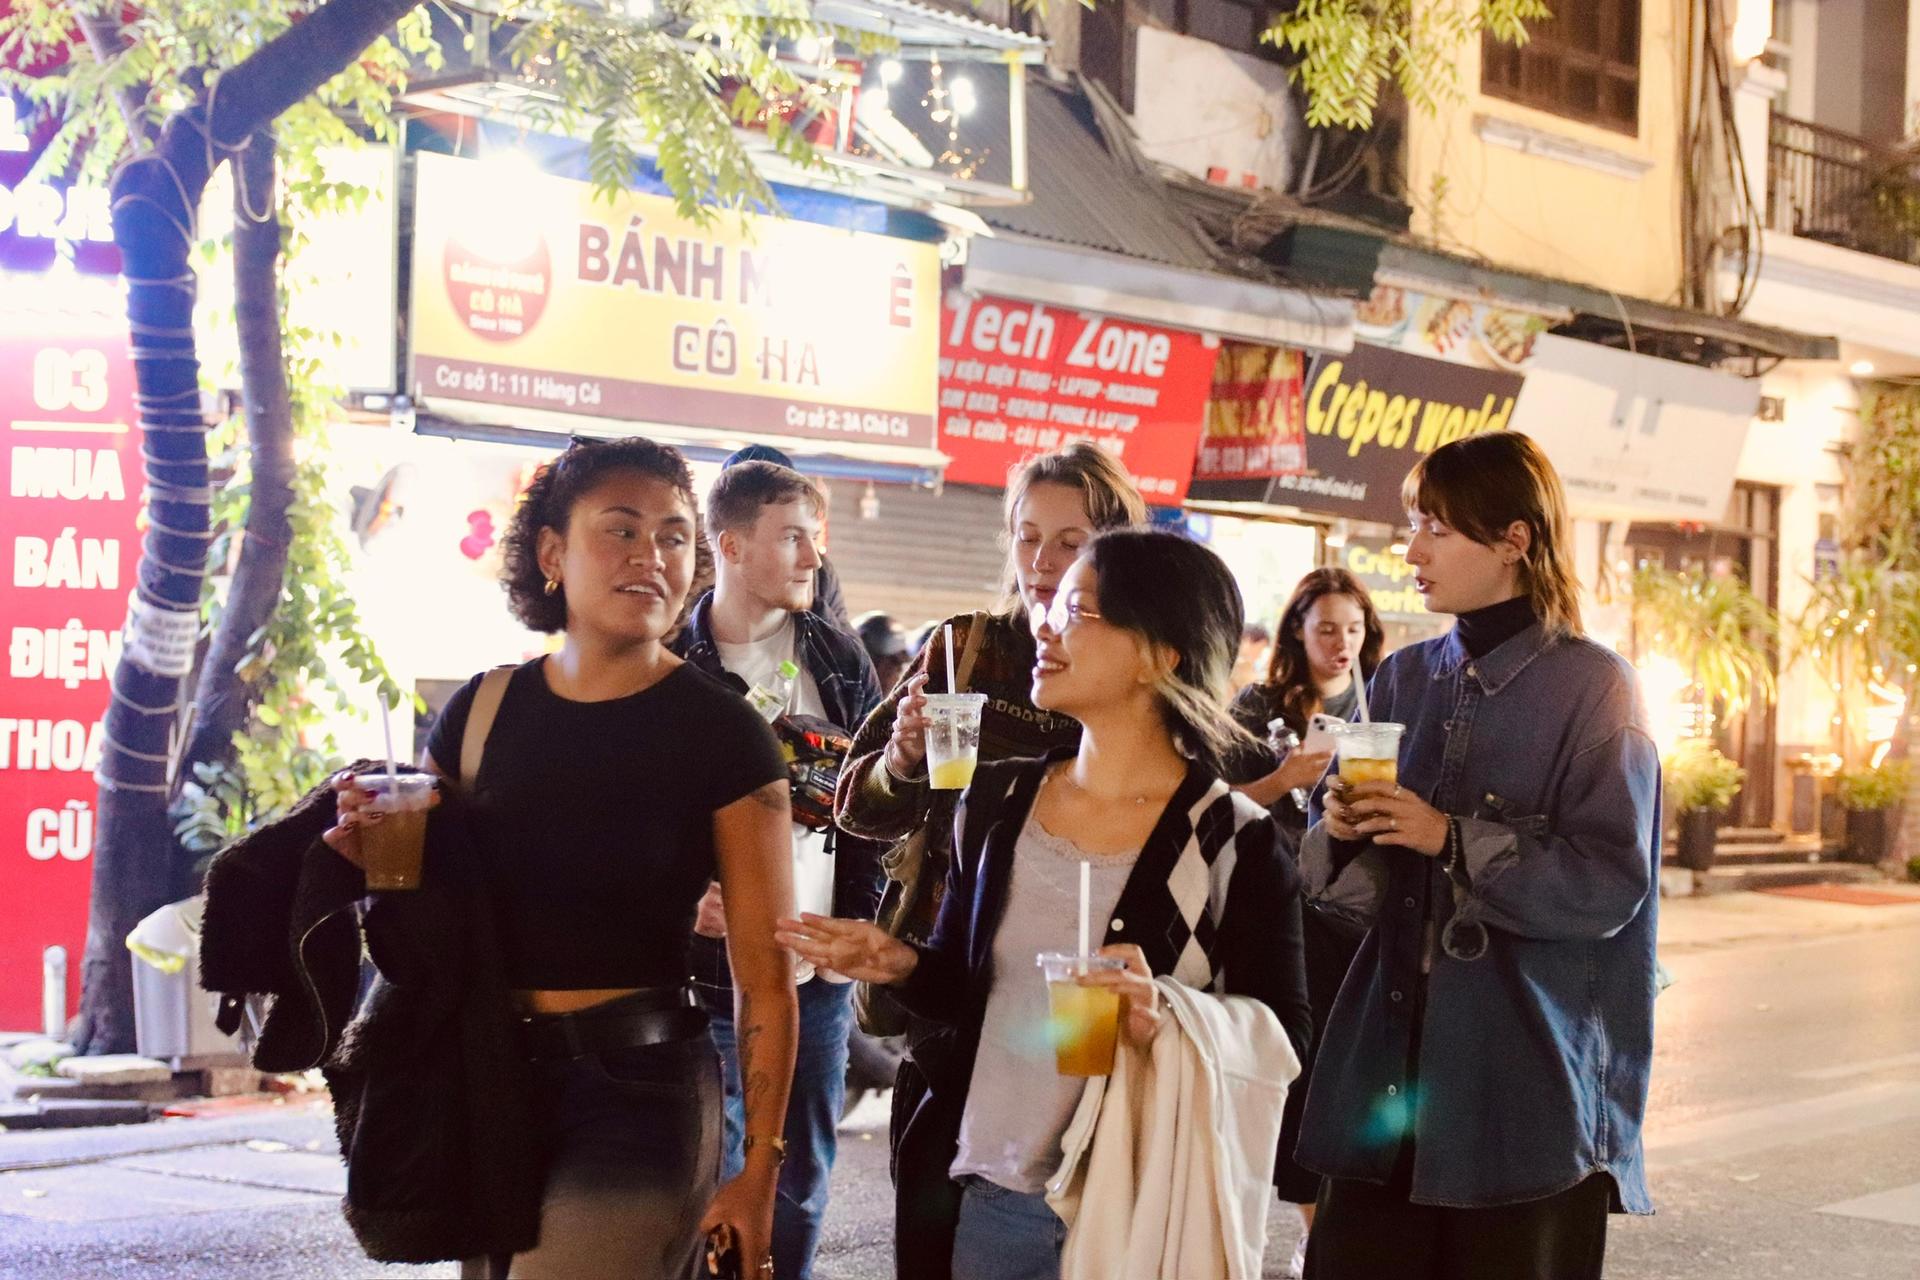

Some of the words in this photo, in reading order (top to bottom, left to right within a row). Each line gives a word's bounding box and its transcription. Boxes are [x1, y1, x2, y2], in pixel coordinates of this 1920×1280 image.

[578, 215, 724, 301] BÁNH
[740, 250, 772, 307] M
[673, 318, 737, 376] CÔ
[944, 296, 1055, 361] Tech
[1065, 312, 1171, 378] Zone
[33, 348, 109, 412] 03
[1306, 360, 1421, 457] Crêpes
[10, 446, 126, 501] MUA
[13, 526, 120, 590] BÁN
[9, 618, 123, 689] ĐIỆN
[26, 799, 93, 861] CŨ
